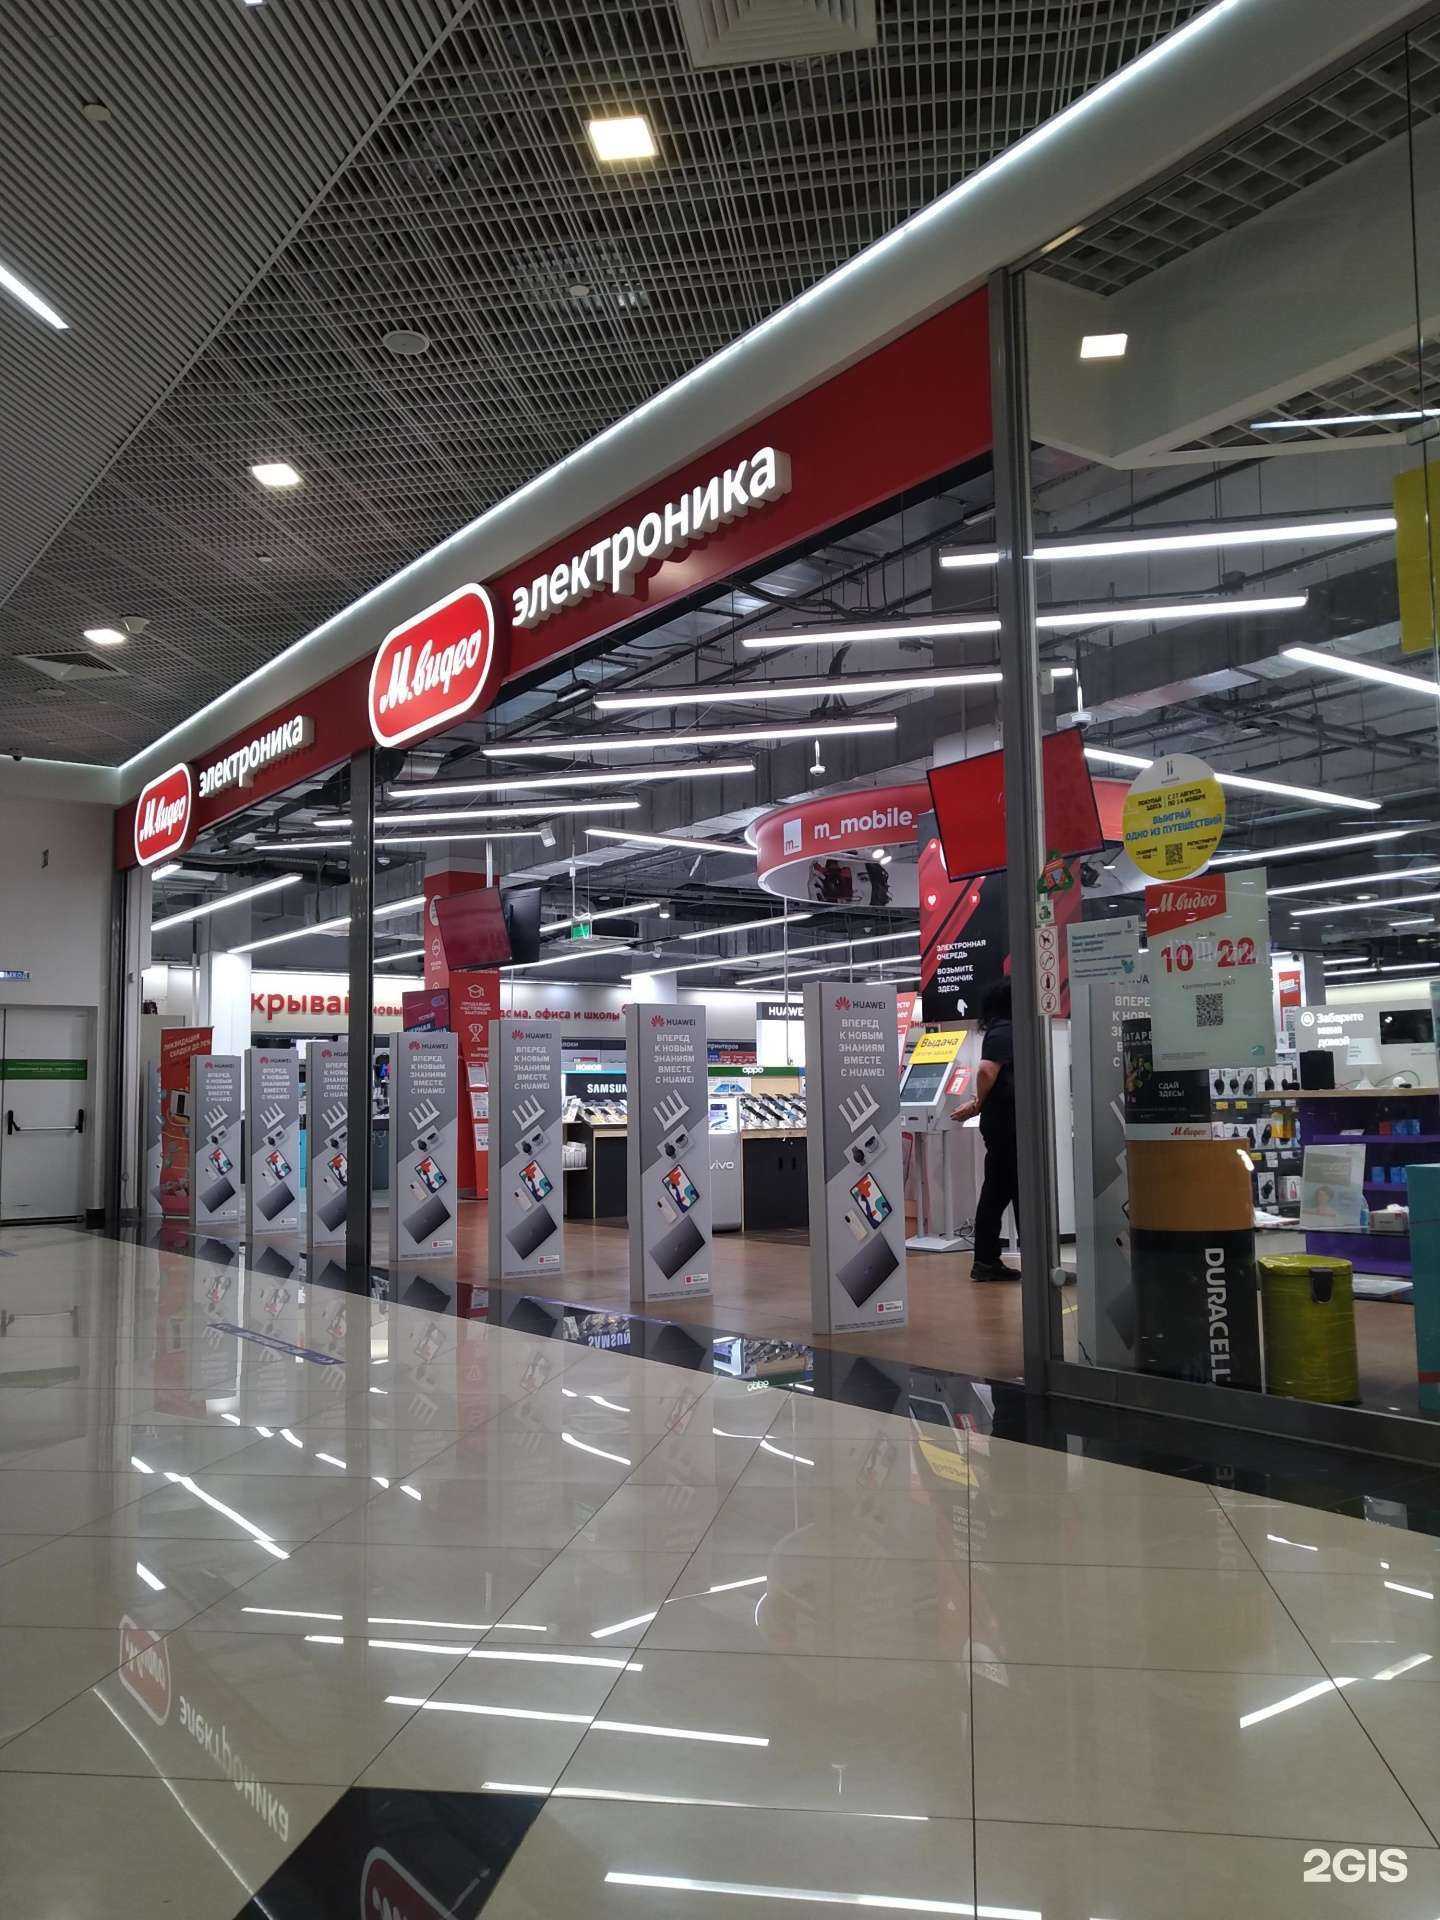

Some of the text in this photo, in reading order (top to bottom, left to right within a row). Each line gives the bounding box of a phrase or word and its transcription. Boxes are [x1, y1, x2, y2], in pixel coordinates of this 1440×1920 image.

[512, 446, 777, 628] электроника
[199, 715, 303, 797] электроника
[936, 939, 986, 951] ЭЛЕКТРОННАЯ
[936, 951, 968, 961] ОЧЕРЕДЬ
[1161, 937, 1257, 973] 10 22
[936, 964, 974, 975] ВОЗЬМИТЕ
[936, 974, 974, 984] ТАЛОНЧИК
[937, 985, 960, 993] ЗДЕСЬ
[853, 1000, 886, 1009] HUAWEI
[1115, 995, 1151, 1007] ВПЕРЕ
[535, 1008, 570, 1019] офиса
[584, 1011, 620, 1020] школы
[769, 1006, 804, 1016] HUAWE
[842, 1019, 880, 1029] ВПЕРЕД
[656, 1034, 691, 1043] ВПЕРЕД
[840, 1031, 883, 1040] К НОВЫМ
[516, 1046, 546, 1054] ВПЕРЕД
[663, 1044, 693, 1052] НОВЫМ
[838, 1044, 885, 1052] ЗНАНИЯМ
[844, 1056, 881, 1064] ВМЕСТЕ
[742, 1067, 764, 1076] oppo
[841, 1069, 885, 1077] С HUAWEI
[663, 1075, 694, 1083] HUAWEI
[521, 1082, 550, 1090] HUAWEI
[587, 1083, 628, 1094] SAMSUN
[1158, 1080, 1180, 1090] СДАЙ
[1158, 1090, 1185, 1098] ЗДЕСЬ!
[1204, 1247, 1231, 1383] DURACELL
